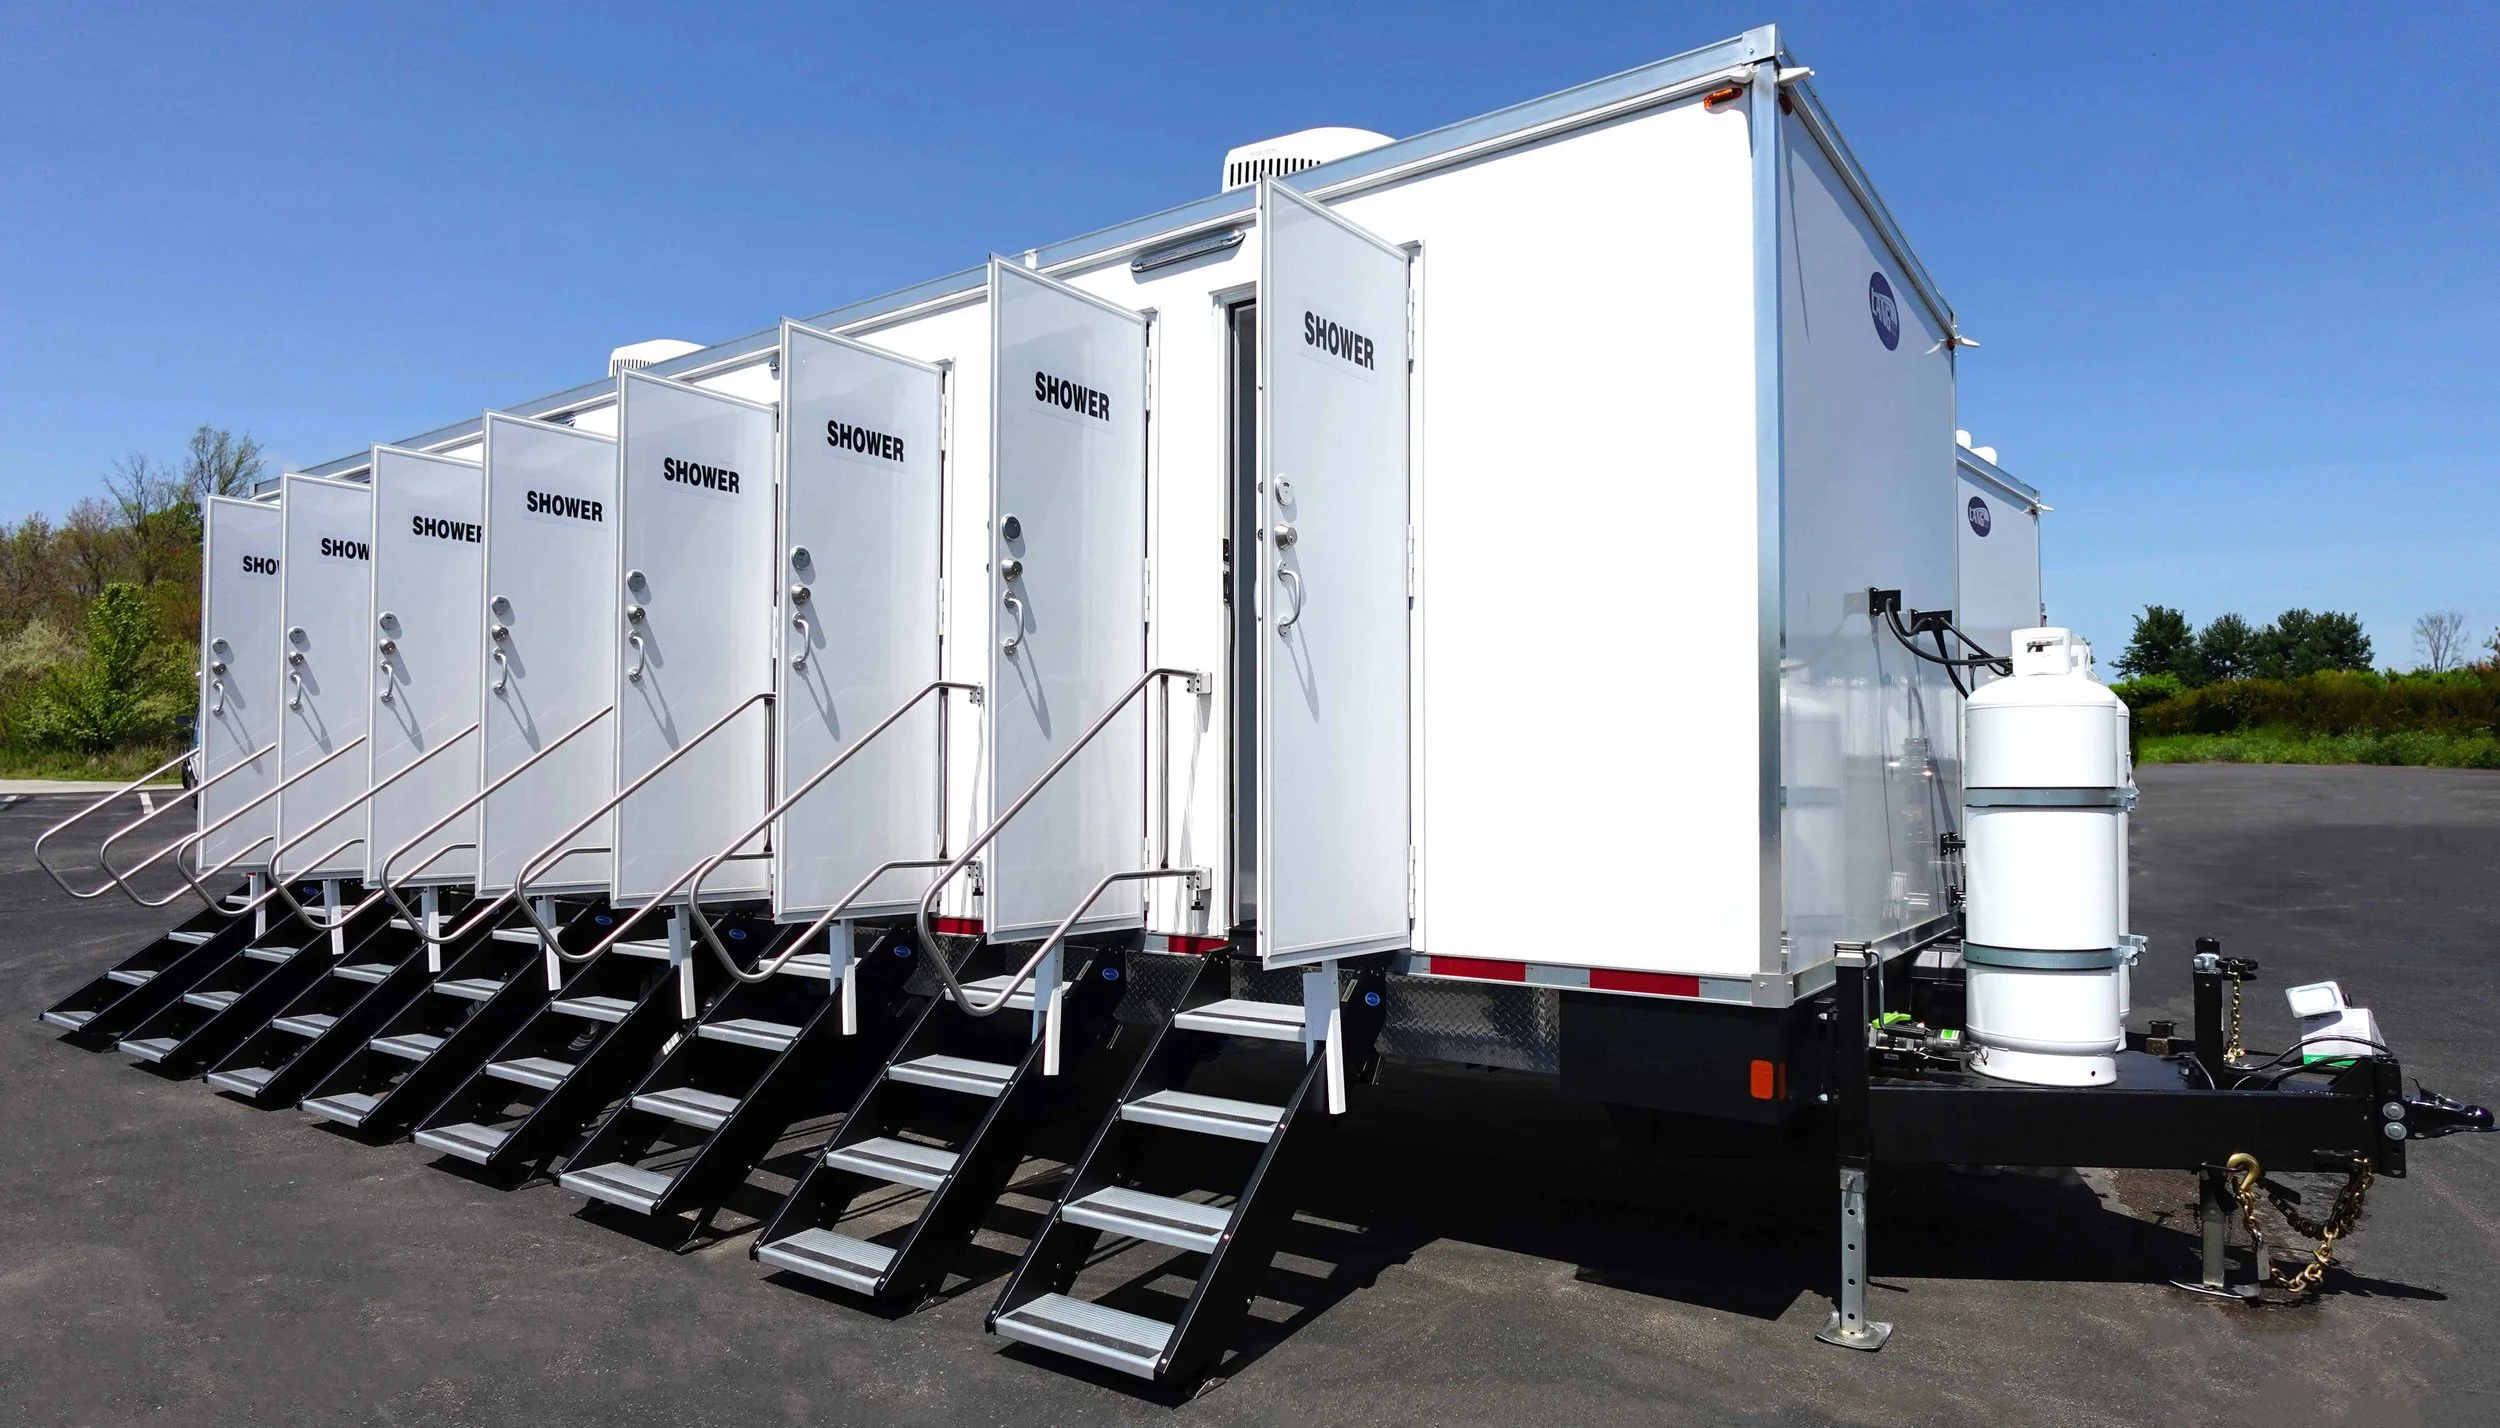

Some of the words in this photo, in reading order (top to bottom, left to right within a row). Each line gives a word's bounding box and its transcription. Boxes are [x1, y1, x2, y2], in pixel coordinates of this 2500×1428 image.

[1304, 310, 1374, 371] SHOWER
[1034, 370, 1110, 422] SHOWER
[826, 419, 904, 463] SHOWER
[663, 456, 740, 494] SHOWER
[526, 490, 603, 523] SHOWER
[242, 555, 280, 576] SHO
